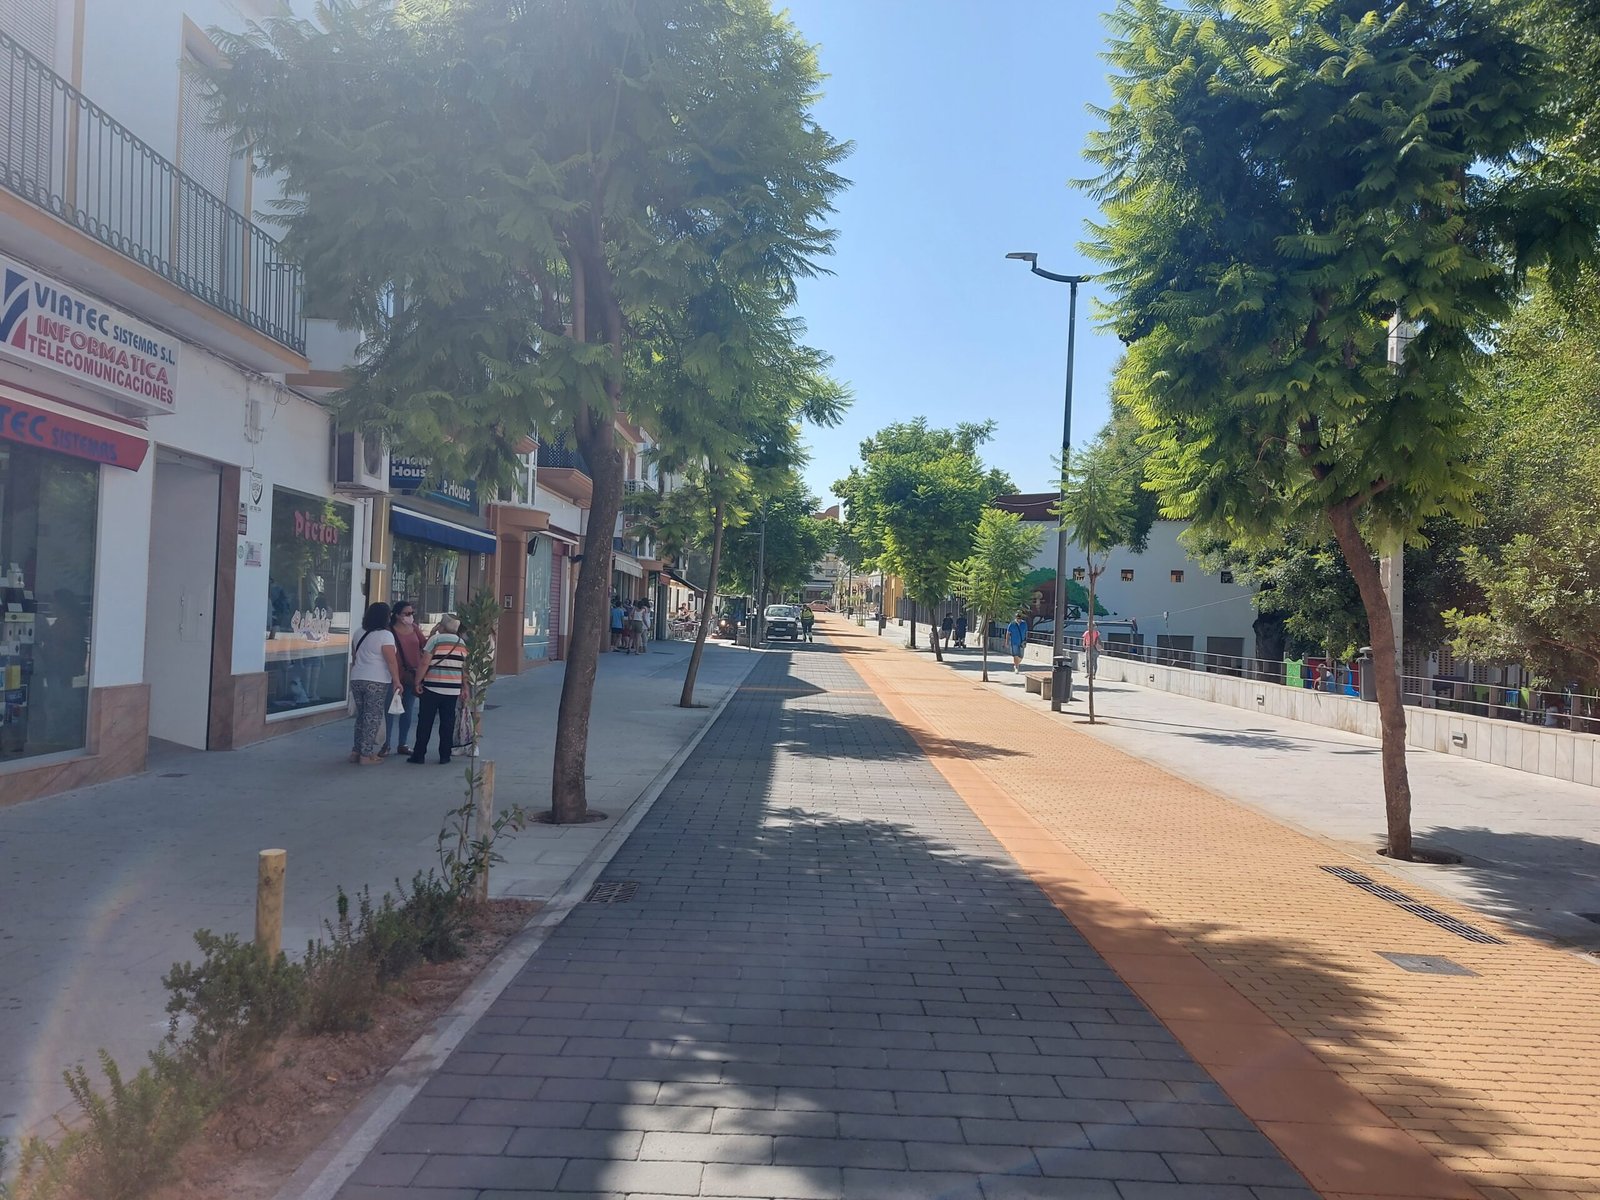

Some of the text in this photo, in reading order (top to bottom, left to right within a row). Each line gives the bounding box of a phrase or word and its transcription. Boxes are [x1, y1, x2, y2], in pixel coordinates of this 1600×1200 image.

[34, 281, 175, 365] VIATEC SISTEMAS S.L.
[36, 315, 169, 385] INFORMATICA
[28, 334, 173, 404] TELECOMUNICACIONES
[51, 427, 117, 462] SISTEMAS
